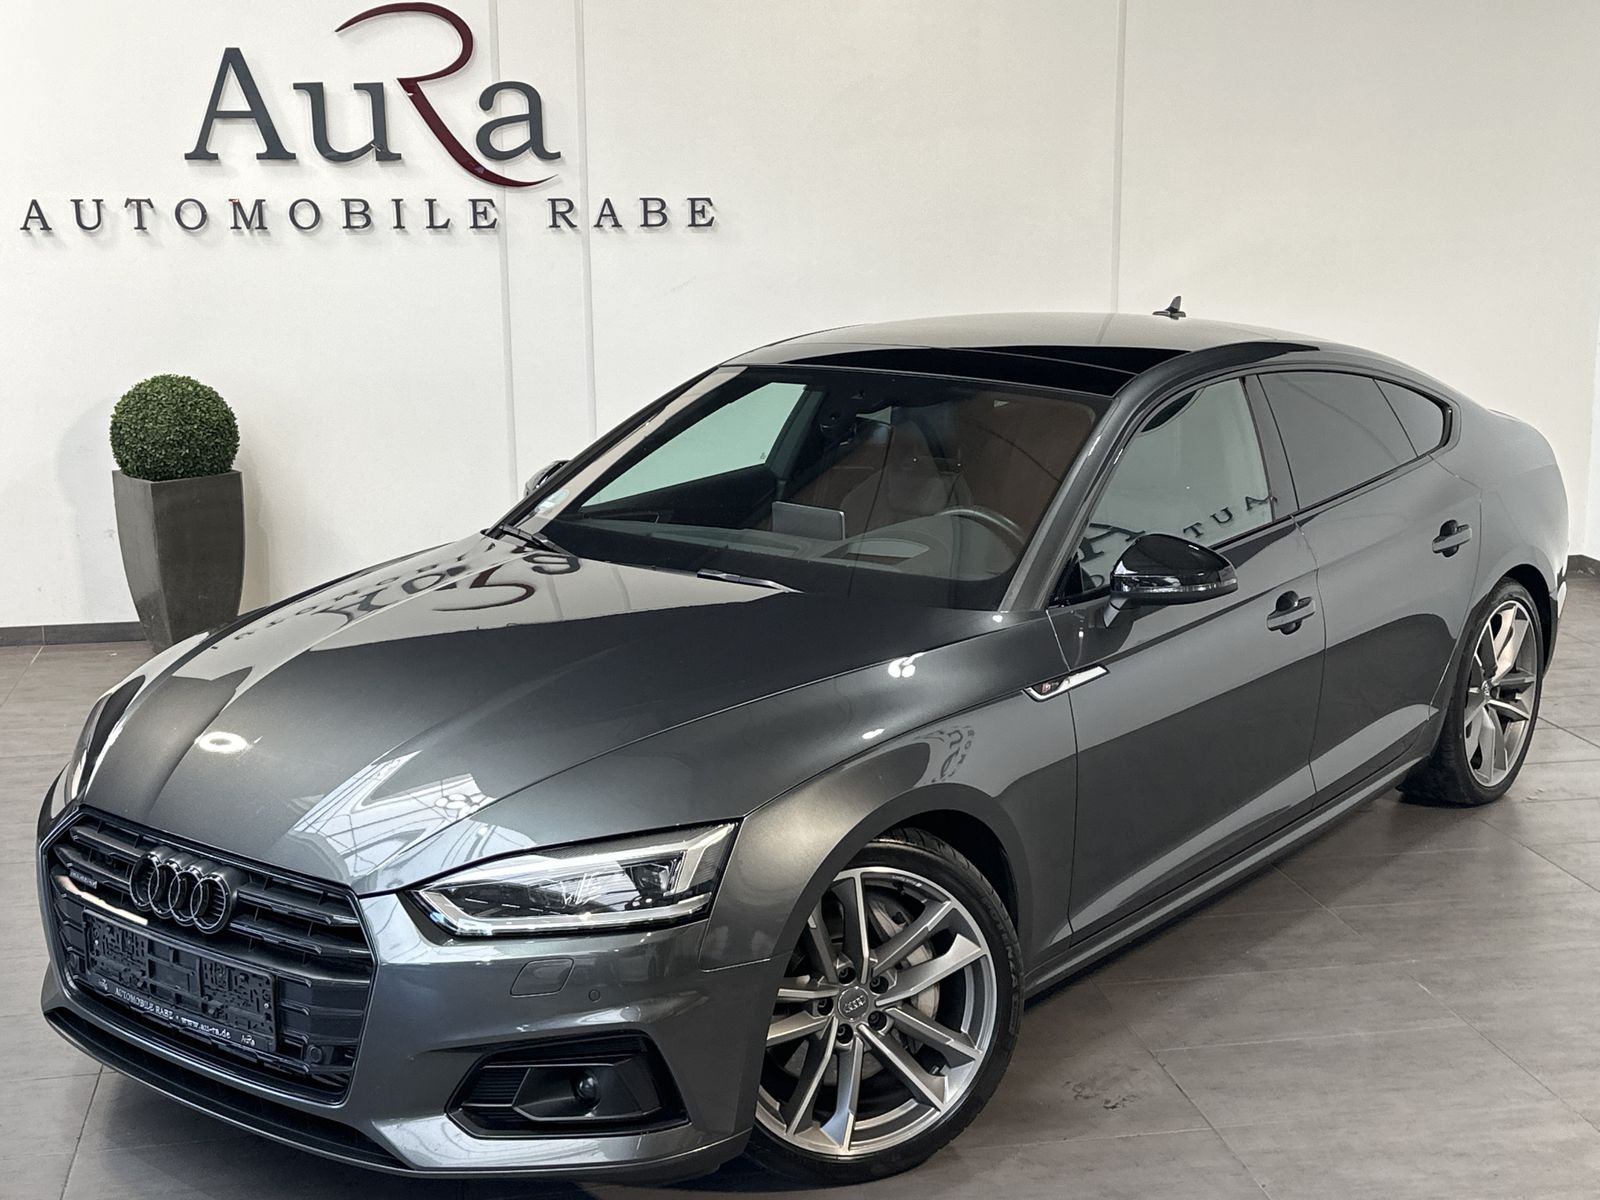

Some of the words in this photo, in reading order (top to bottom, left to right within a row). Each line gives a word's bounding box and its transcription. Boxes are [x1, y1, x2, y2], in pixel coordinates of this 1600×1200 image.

[184, 2, 562, 189] AuRa
[20, 198, 498, 231] AUTOMOBILE
[548, 197, 717, 230] RABE
